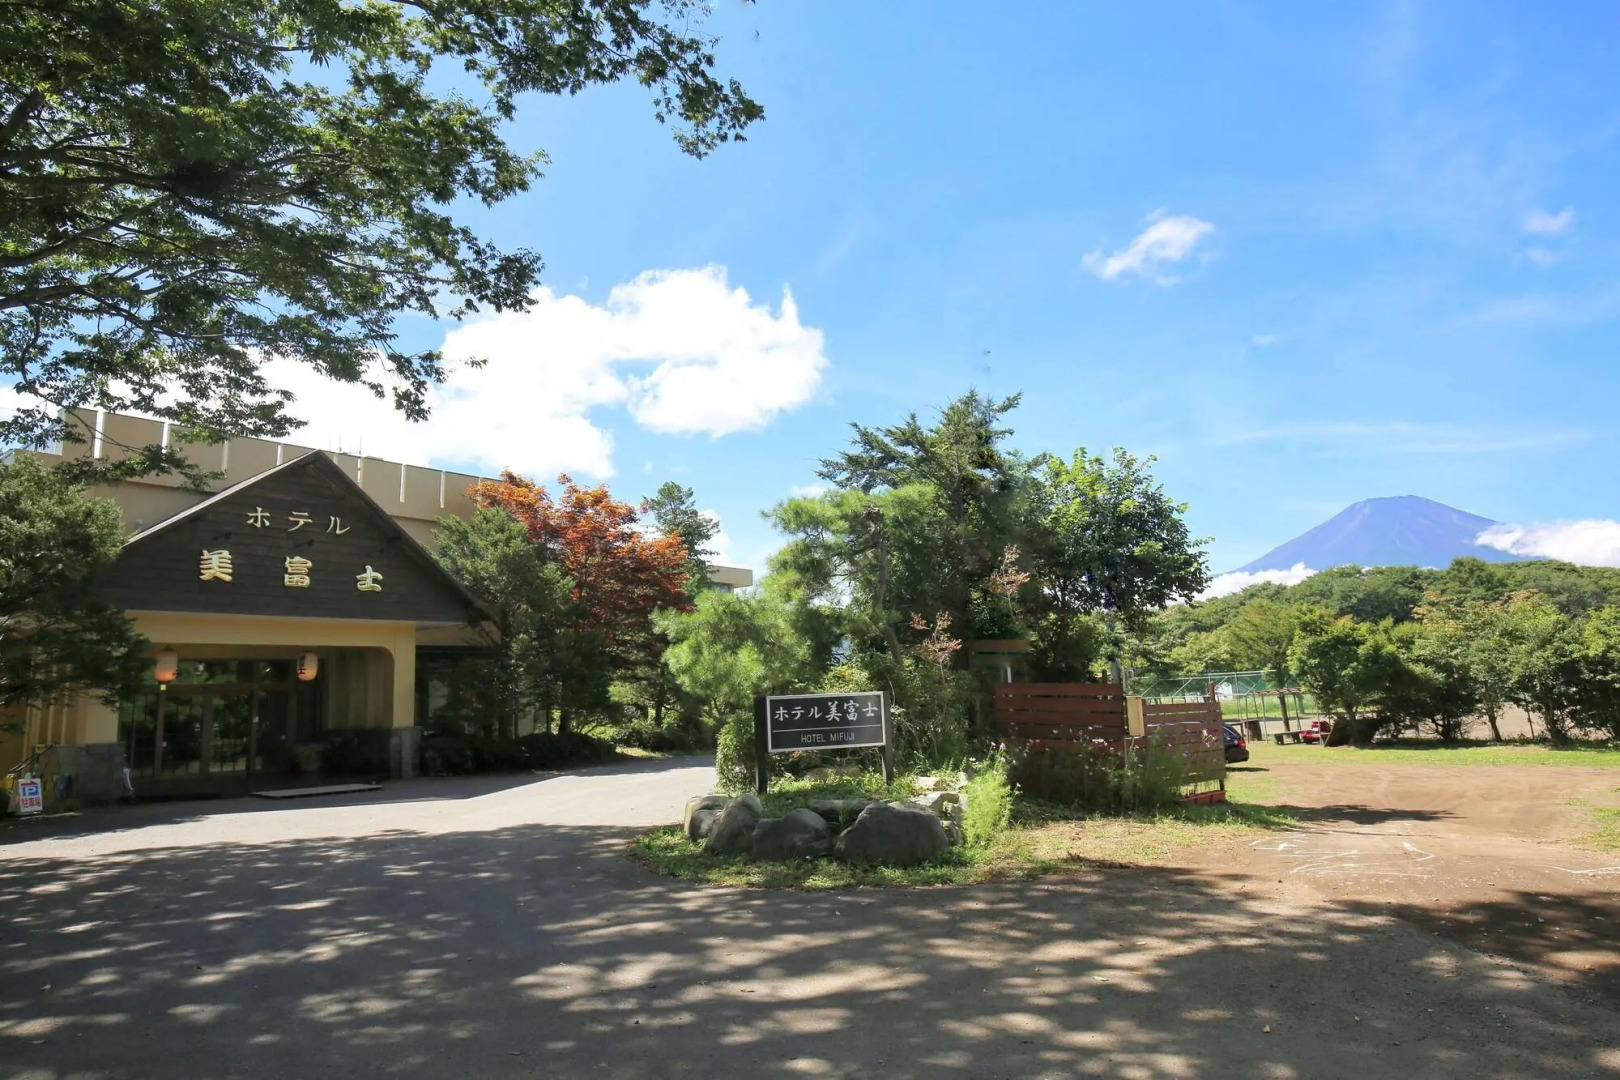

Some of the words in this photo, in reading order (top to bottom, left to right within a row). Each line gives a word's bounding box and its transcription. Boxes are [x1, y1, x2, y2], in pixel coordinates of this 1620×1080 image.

[247, 507, 350, 535] ホテル
[199, 549, 383, 592] 美富士
[774, 700, 878, 722] ホテル美富士
[801, 734, 825, 743] HOTEL
[830, 732, 855, 742] MIFUJI
[25, 787, 37, 796] P
